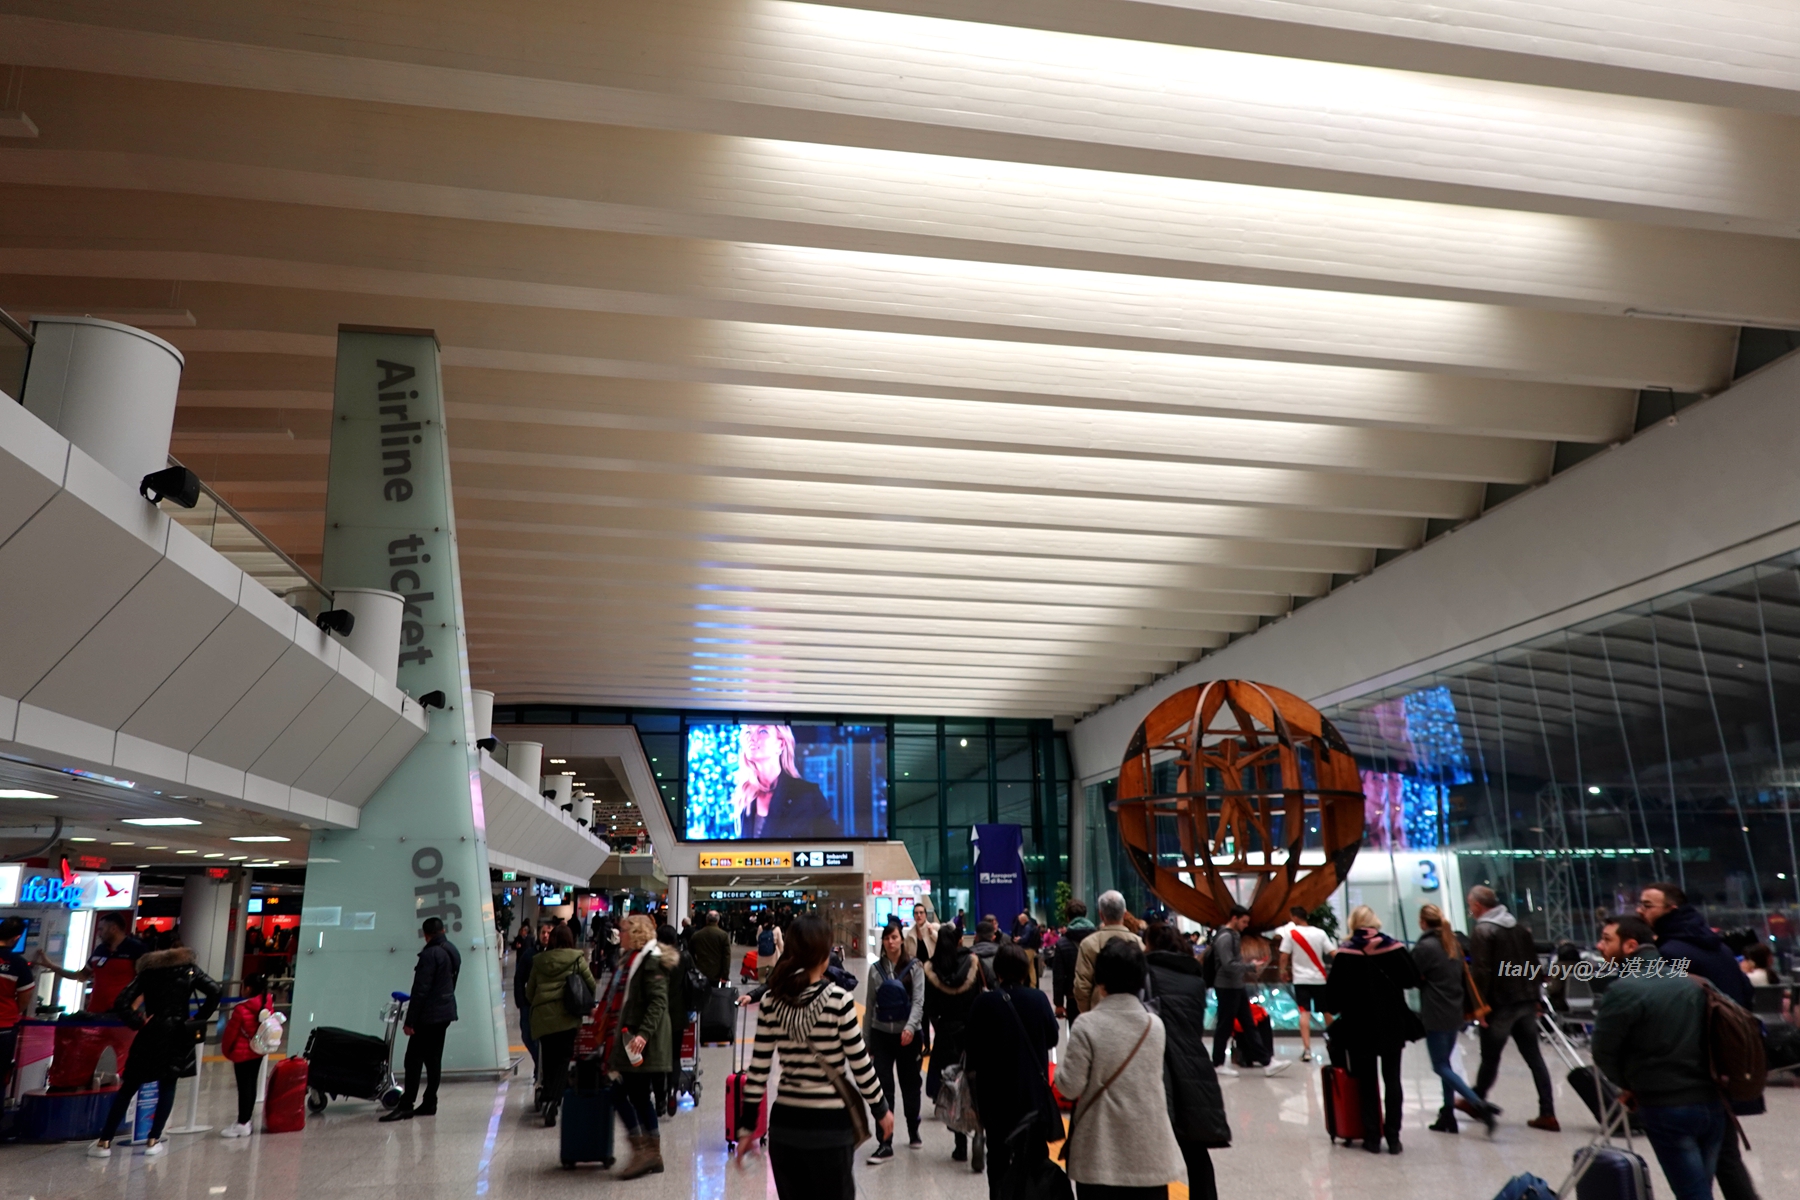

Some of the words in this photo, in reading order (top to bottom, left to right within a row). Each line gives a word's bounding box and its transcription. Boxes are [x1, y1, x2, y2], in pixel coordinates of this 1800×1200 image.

[376, 359, 422, 502] Airline
[388, 533, 435, 668] ticket
[1418, 860, 1439, 893] 3
